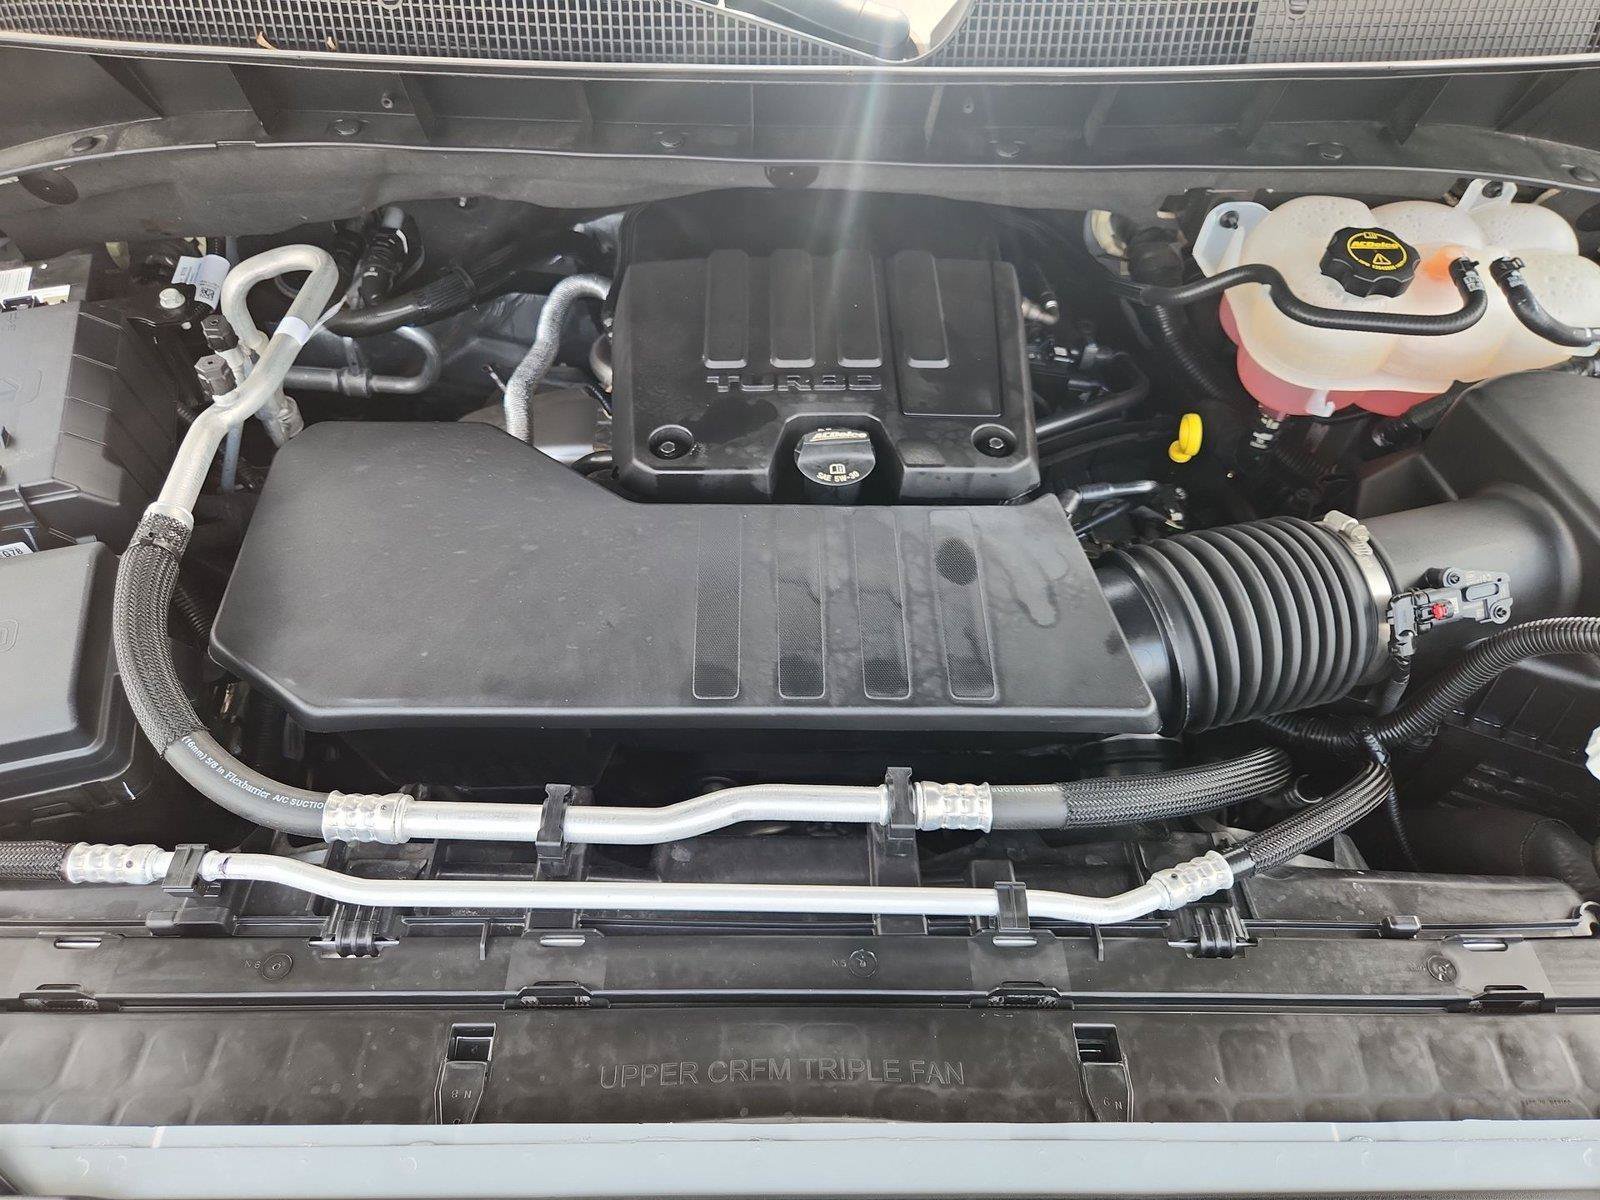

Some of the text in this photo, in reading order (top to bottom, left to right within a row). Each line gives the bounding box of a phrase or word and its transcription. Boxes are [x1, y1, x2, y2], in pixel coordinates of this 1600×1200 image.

[816, 470, 860, 483] SAE 5W-30
[181, 735, 208, 761] (16mm)
[204, 756, 219, 770] 5/8
[224, 770, 271, 799] Flexbarrier
[272, 794, 289, 804] A/C
[289, 797, 324, 810] SUCTIO
[600, 1057, 965, 1090] UPPER CRFM TRIPLE FAN
